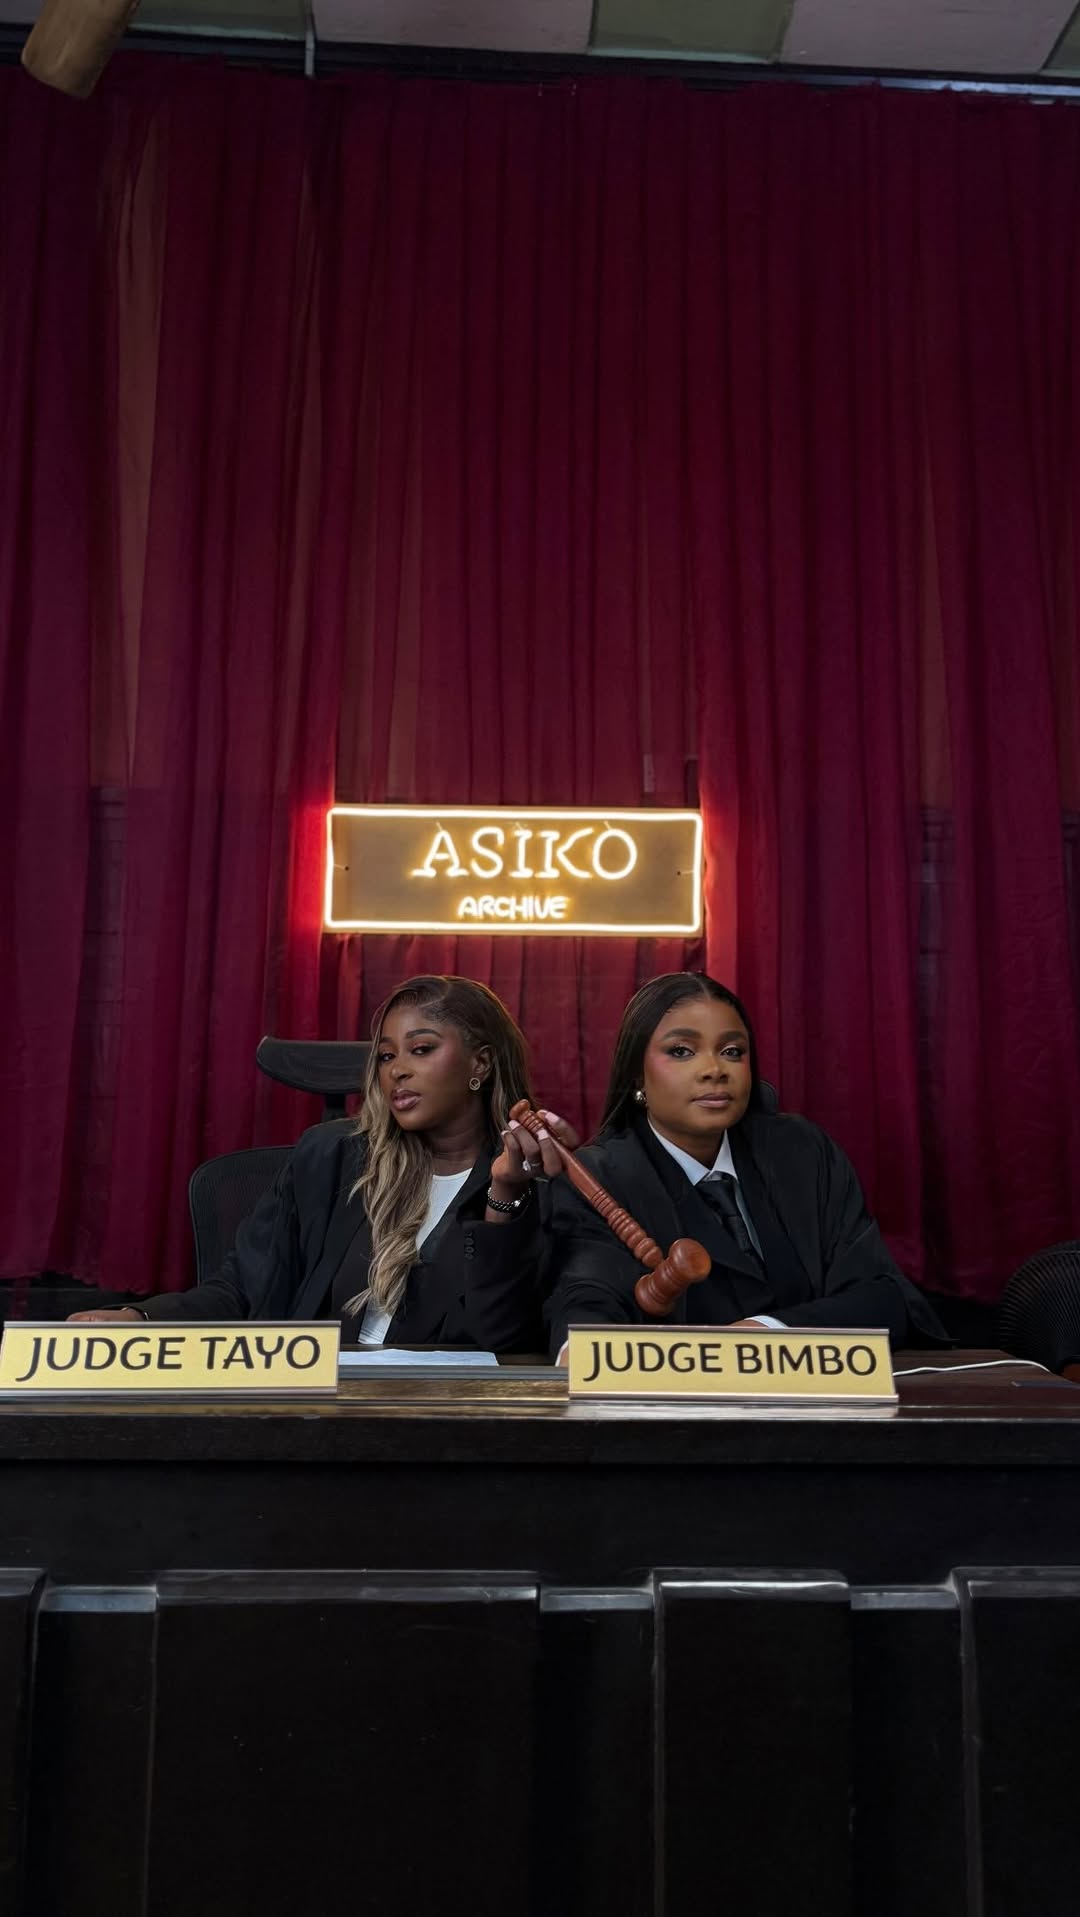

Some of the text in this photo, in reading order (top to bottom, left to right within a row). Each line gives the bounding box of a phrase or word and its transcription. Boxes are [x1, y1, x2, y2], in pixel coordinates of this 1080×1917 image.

[411, 826, 638, 880] ASIKO
[457, 895, 568, 919] ARCHIVE
[15, 1335, 321, 1382] JUDGE TAYO
[583, 1341, 877, 1382] JUDGE BIMBO
